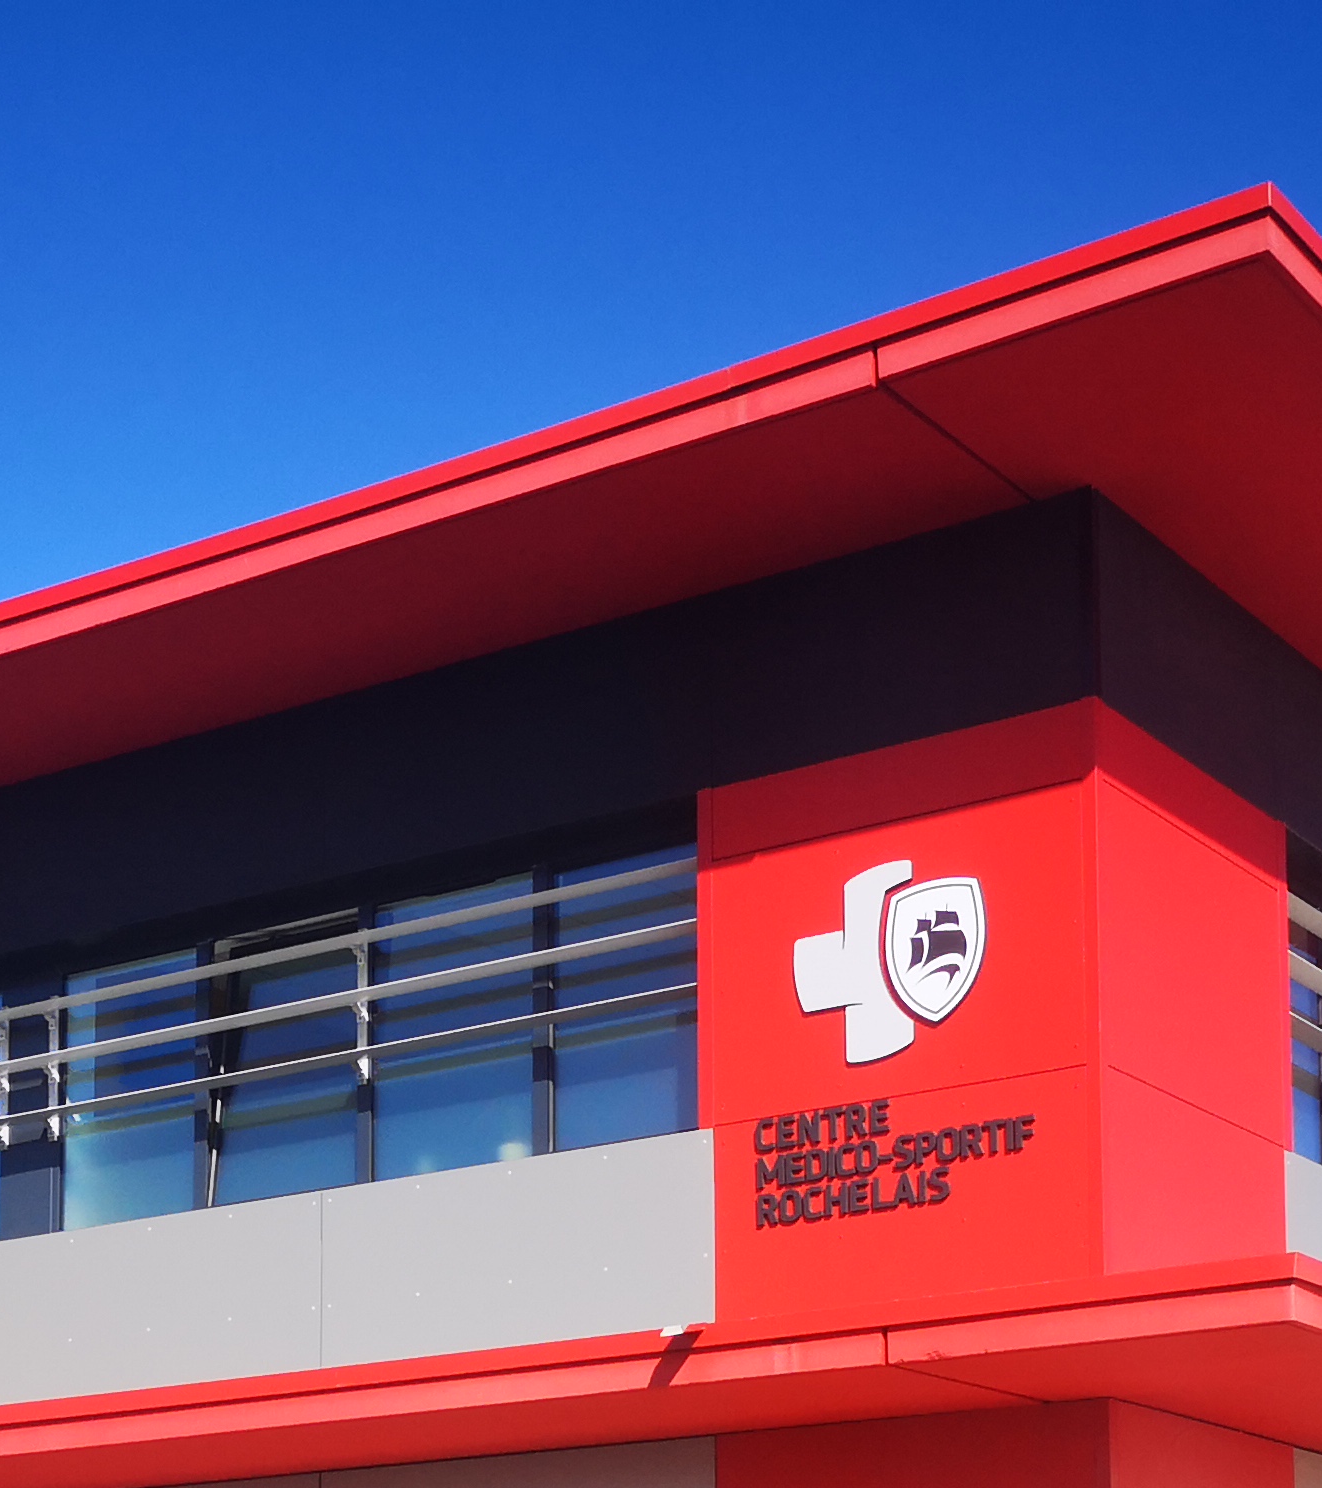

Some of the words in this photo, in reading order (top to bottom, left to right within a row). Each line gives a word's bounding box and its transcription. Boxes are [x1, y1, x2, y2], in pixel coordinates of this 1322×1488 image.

[754, 1100, 890, 1155] CENTRE
[755, 1114, 1035, 1193] MEDICO-SPORTIF
[755, 1166, 951, 1230] ROCHELAIS
